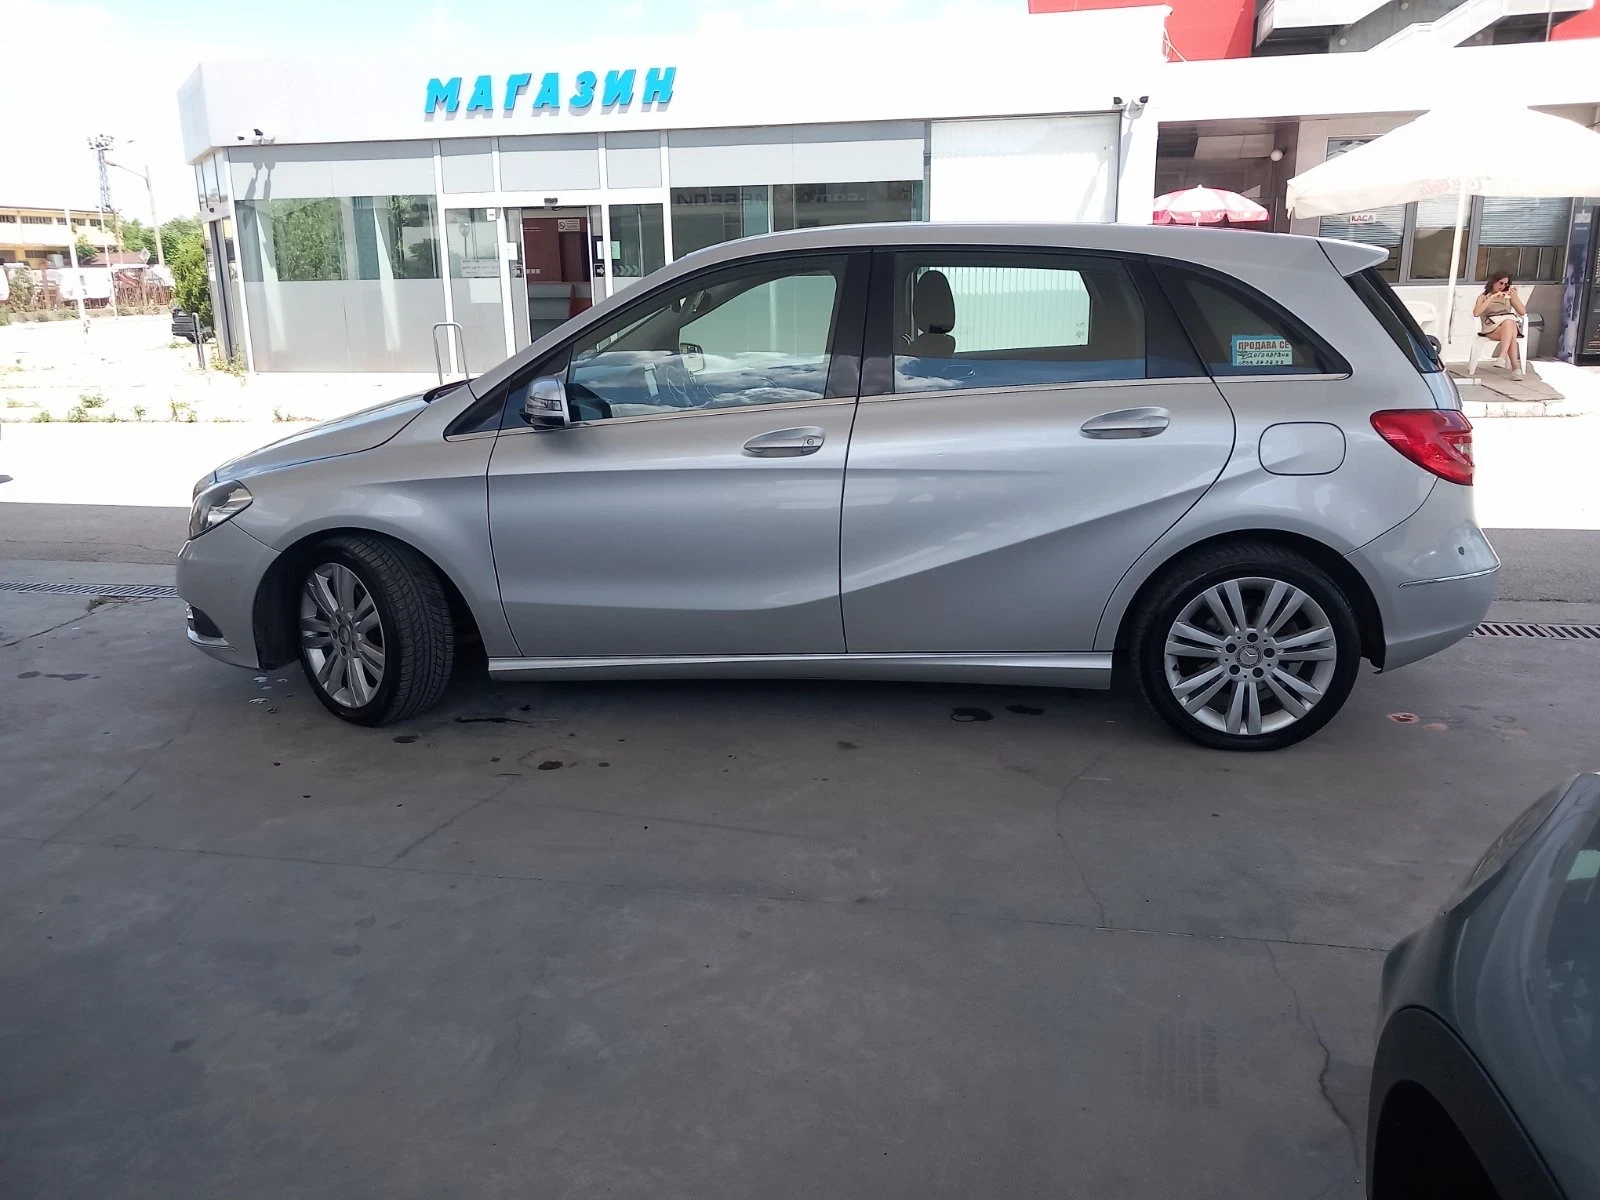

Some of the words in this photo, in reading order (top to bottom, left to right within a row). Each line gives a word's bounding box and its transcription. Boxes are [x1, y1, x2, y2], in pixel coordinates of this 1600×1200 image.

[424, 66, 677, 114] МАГАЗИН
[1351, 214, 1374, 222] КАСА
[1238, 340, 1277, 350] ПРОДАВА
[1279, 340, 1289, 349] СЕ
